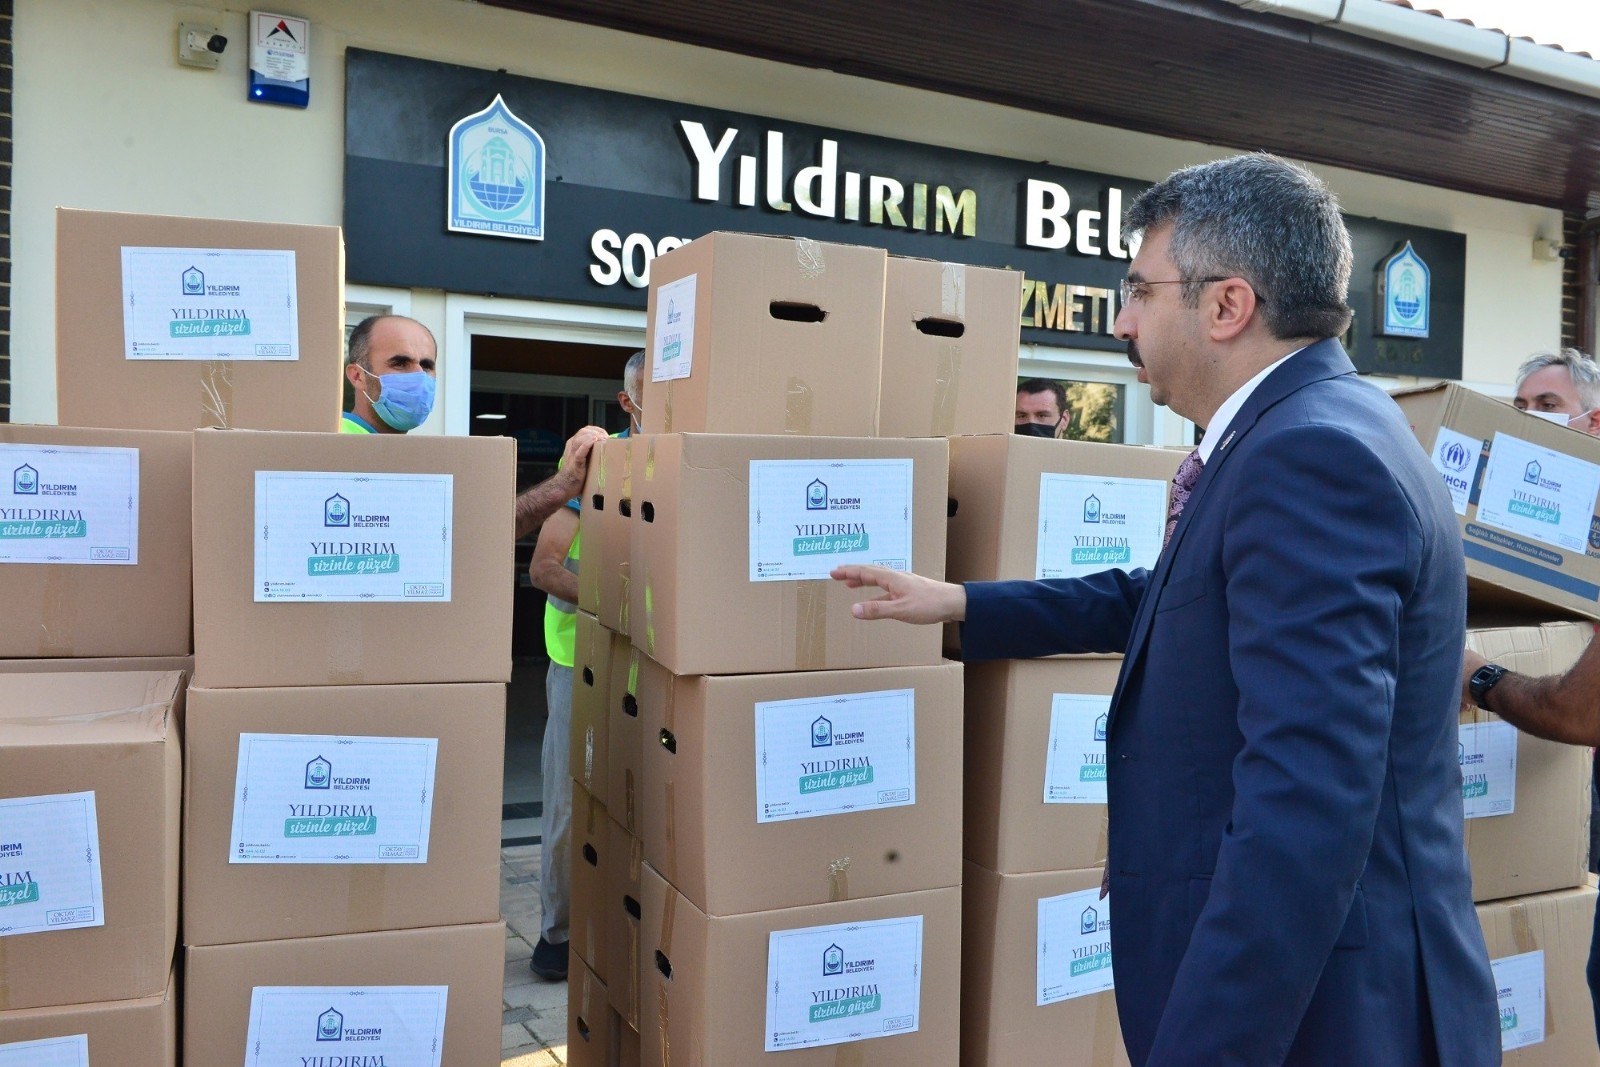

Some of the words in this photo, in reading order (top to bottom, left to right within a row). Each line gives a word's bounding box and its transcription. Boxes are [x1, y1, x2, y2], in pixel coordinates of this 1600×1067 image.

[454, 219, 491, 230] YILDIRIM
[171, 308, 246, 319] YILDIRIM
[175, 320, 210, 334] sizinle
[214, 319, 246, 336] güzel
[1514, 489, 1560, 512] YILDIRIM
[0, 508, 82, 520] YILDIRIM
[2, 520, 42, 535] sizinle
[45, 520, 80, 538] güzel
[795, 523, 866, 536] YILDIRIM
[310, 542, 395, 554] YILDIRIM
[798, 536, 831, 552] sizinle
[834, 533, 865, 553] güzel
[1074, 536, 1128, 547] YILDIRIM
[314, 556, 353, 572] sizinle
[357, 554, 393, 574] güzel
[834, 732, 864, 740] YILDIRIM
[801, 756, 870, 774] YILDIRIM
[804, 773, 836, 790] sizinle
[839, 767, 869, 788] güzel
[289, 804, 374, 817] YILDIRIM
[290, 818, 330, 834] sizinle
[334, 816, 371, 836] güzel
[845, 959, 875, 968] YILDIRIM
[812, 984, 879, 1003] YILDIRIM
[814, 1000, 845, 1018] sizinle
[848, 996, 877, 1017] güzel
[301, 1055, 385, 1067] YILDIRIM
